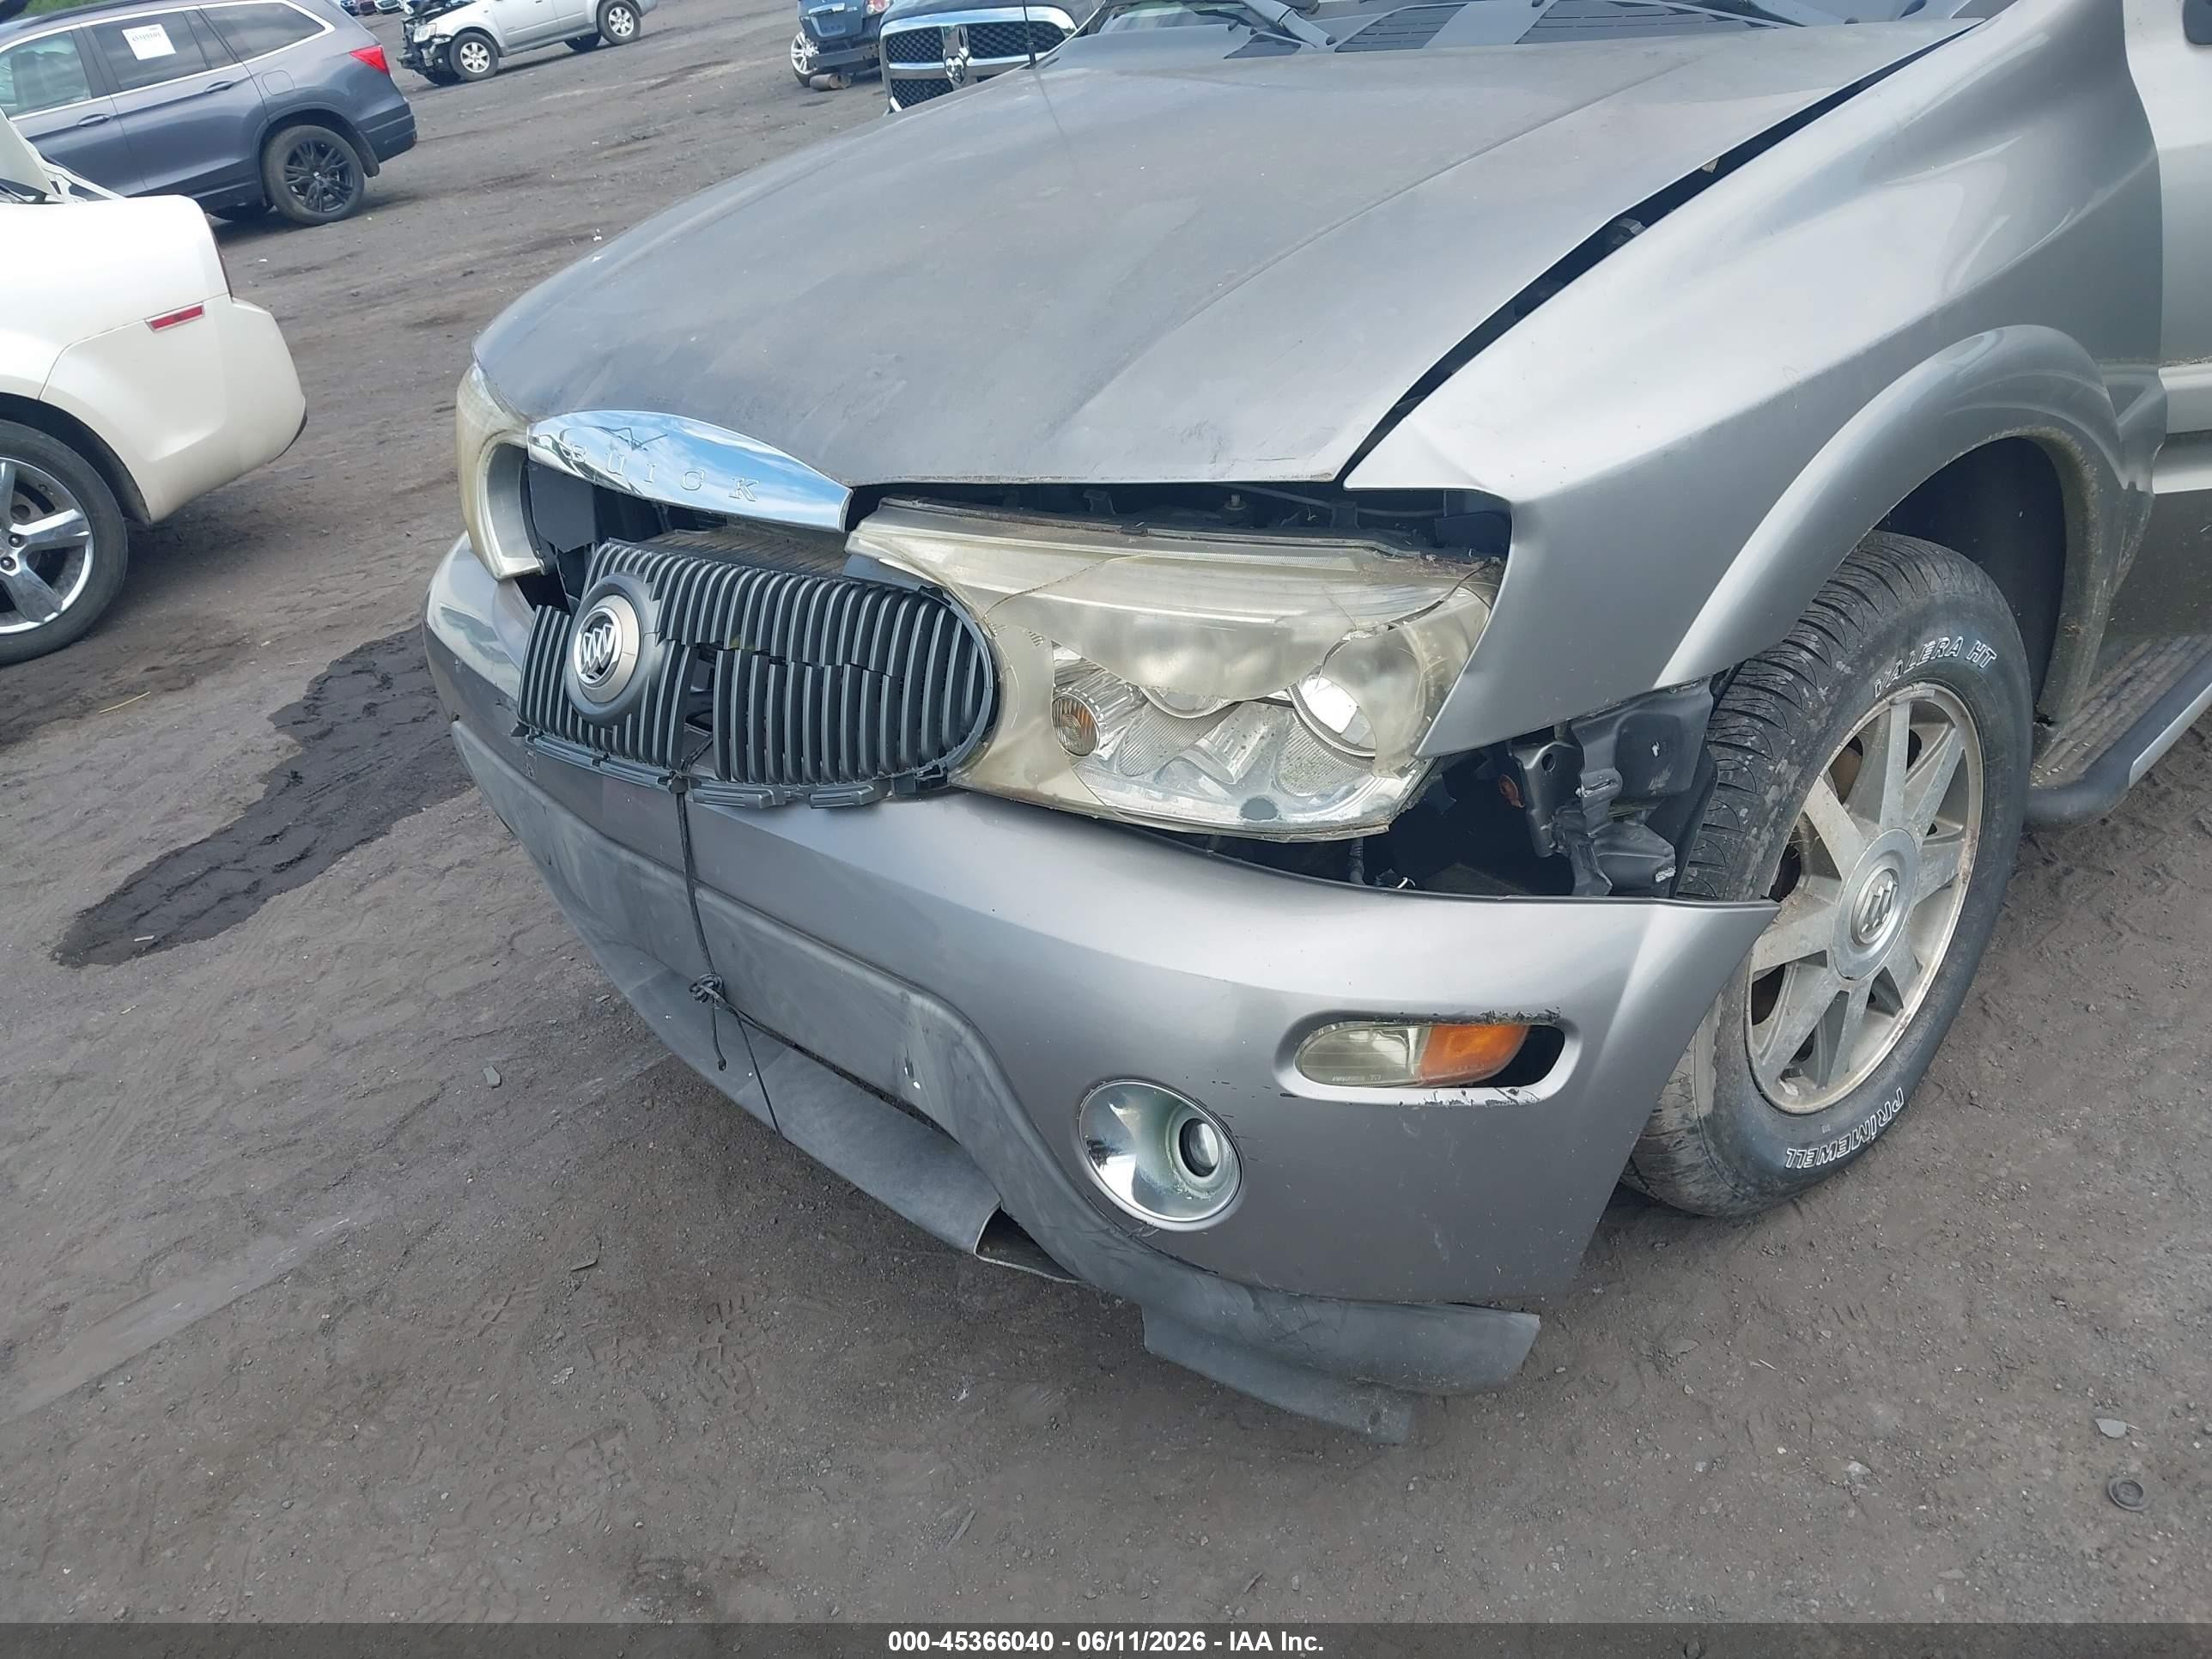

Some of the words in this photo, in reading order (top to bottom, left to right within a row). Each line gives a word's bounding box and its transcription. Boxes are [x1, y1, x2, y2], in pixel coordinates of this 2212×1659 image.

[570, 443, 759, 501] BUICK
[1875, 635, 1964, 698] VALERA
[1966, 639, 1998, 669] HT
